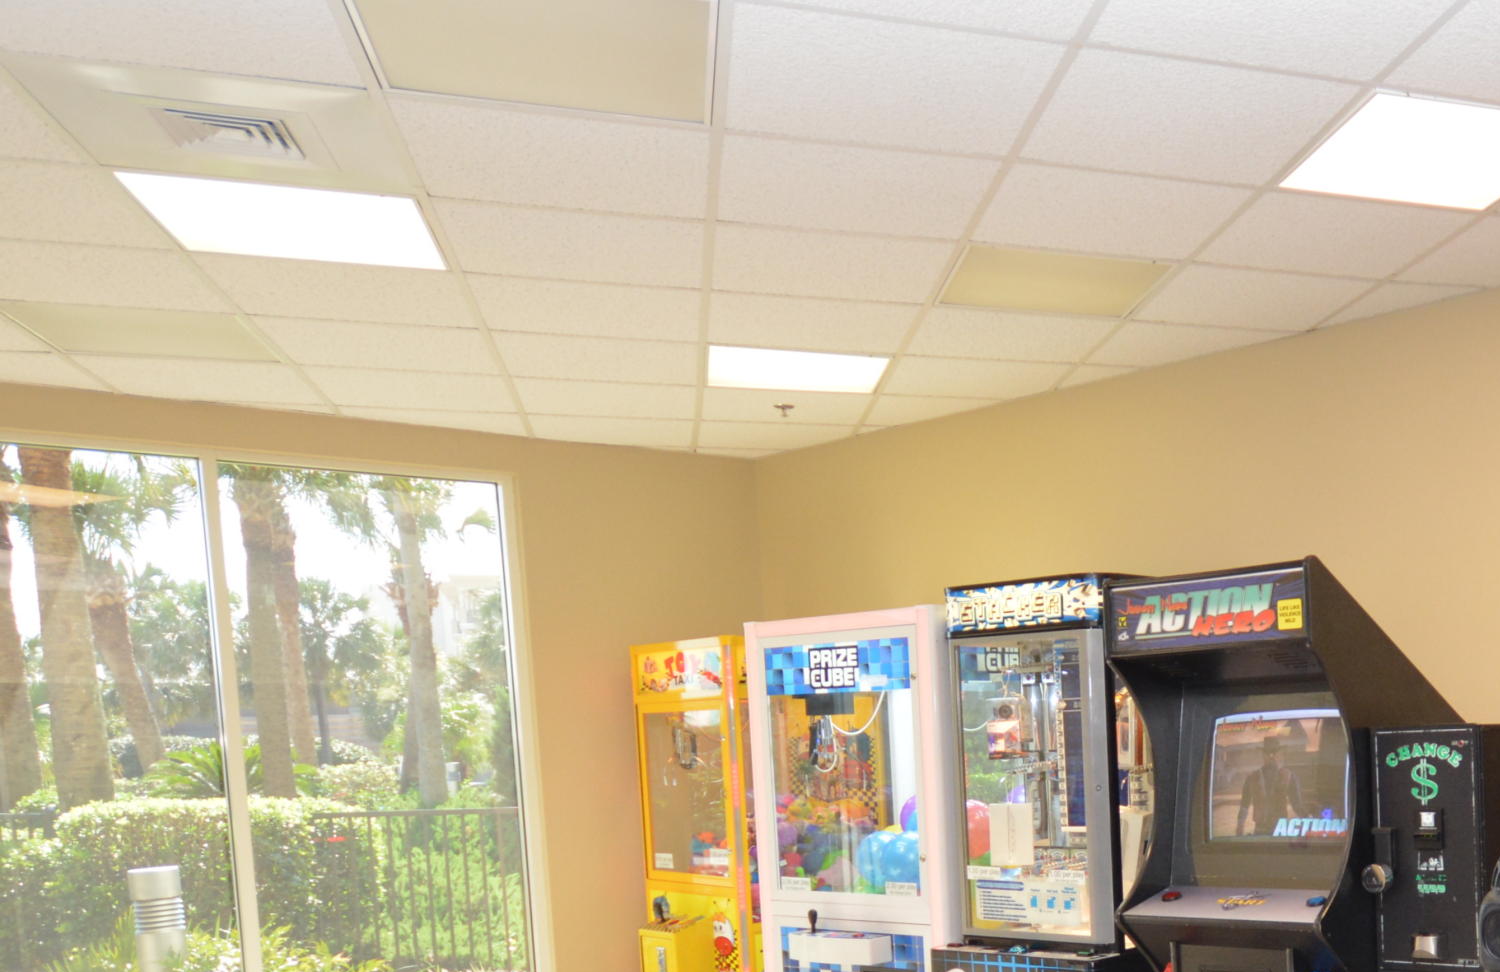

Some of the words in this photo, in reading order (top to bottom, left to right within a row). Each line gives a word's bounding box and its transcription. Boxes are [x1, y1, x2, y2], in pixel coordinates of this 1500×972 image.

[1135, 582, 1274, 635] ACTION
[1191, 608, 1276, 637] HERO
[809, 647, 858, 668] PRIZE
[811, 667, 855, 687] CUBE
[1386, 742, 1463, 768] CHANGE
